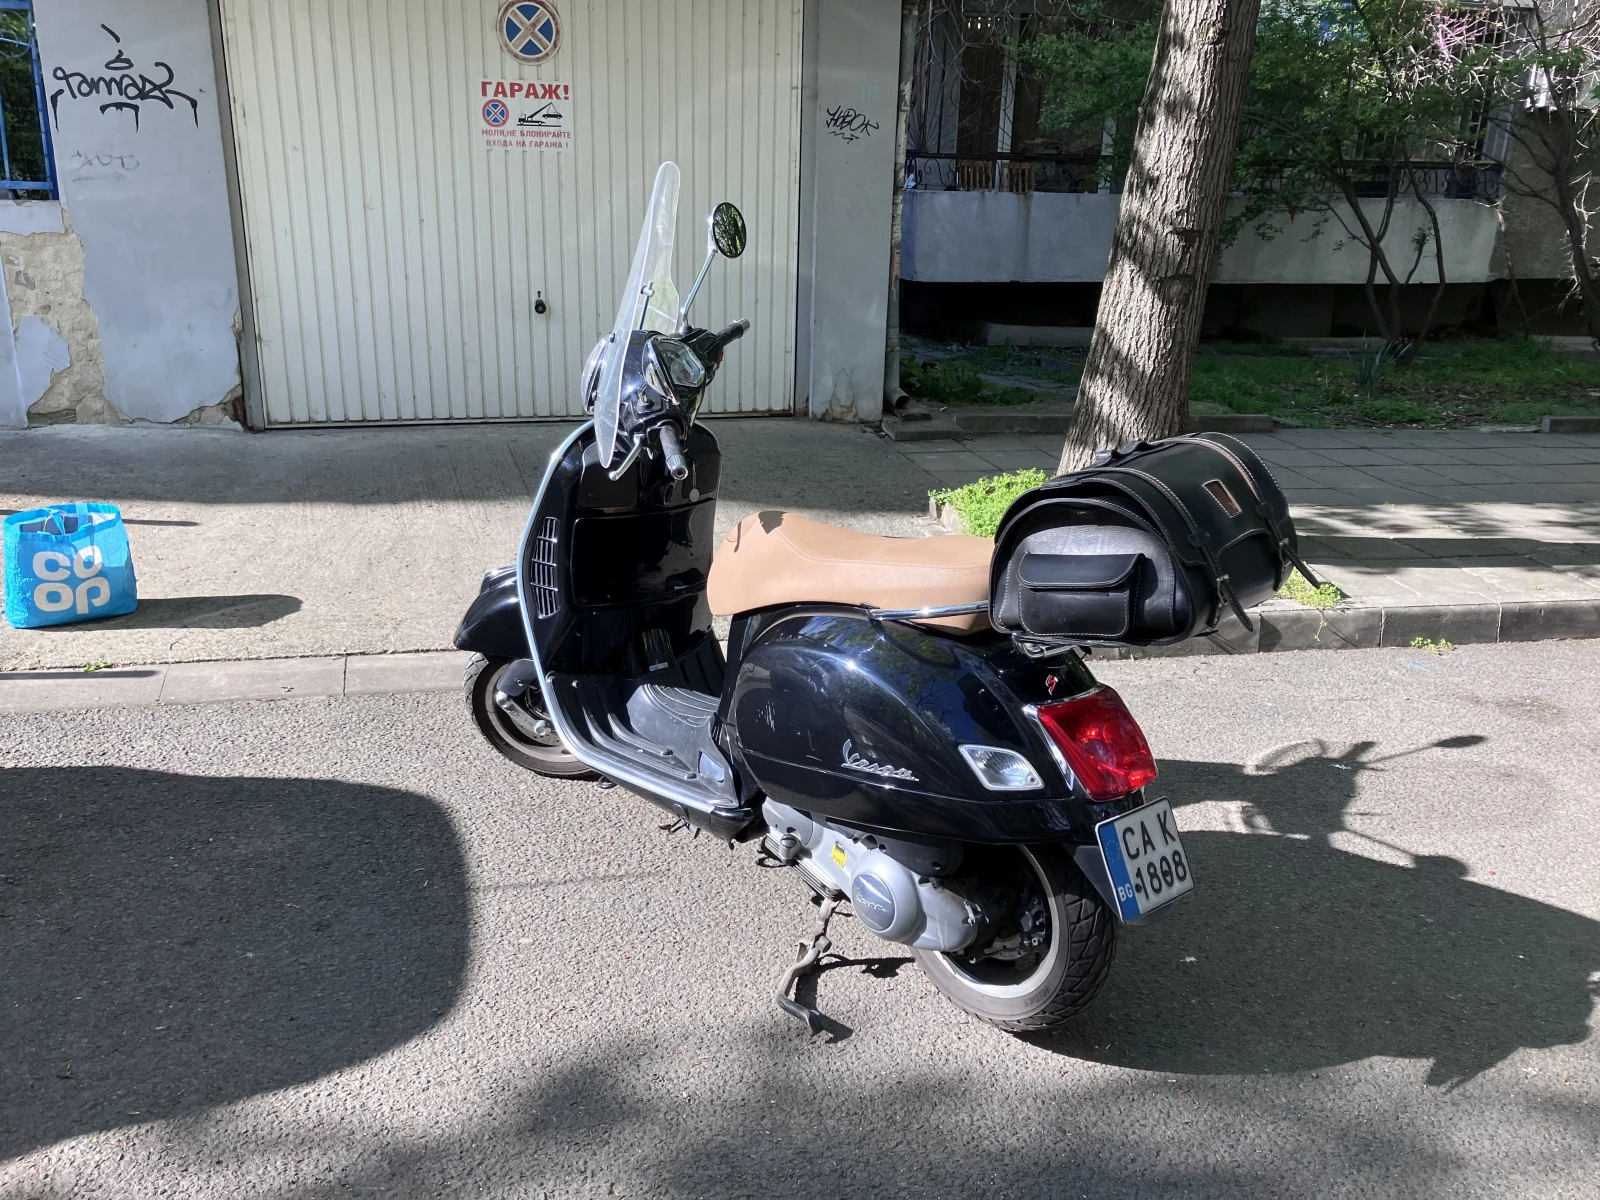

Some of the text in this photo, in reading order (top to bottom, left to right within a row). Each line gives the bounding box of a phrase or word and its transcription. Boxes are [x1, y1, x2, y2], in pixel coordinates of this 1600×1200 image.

[481, 81, 570, 100] ГАРАЖ!
[486, 139, 513, 148] ВХОДА
[516, 140, 527, 148] НА
[529, 140, 563, 149] ГАРАЖА
[520, 130, 572, 139] БЛОКИРАЙТЕ
[841, 739, 920, 782] Vespa
[1122, 810, 1176, 860] CA K
[1118, 883, 1134, 902] BG
